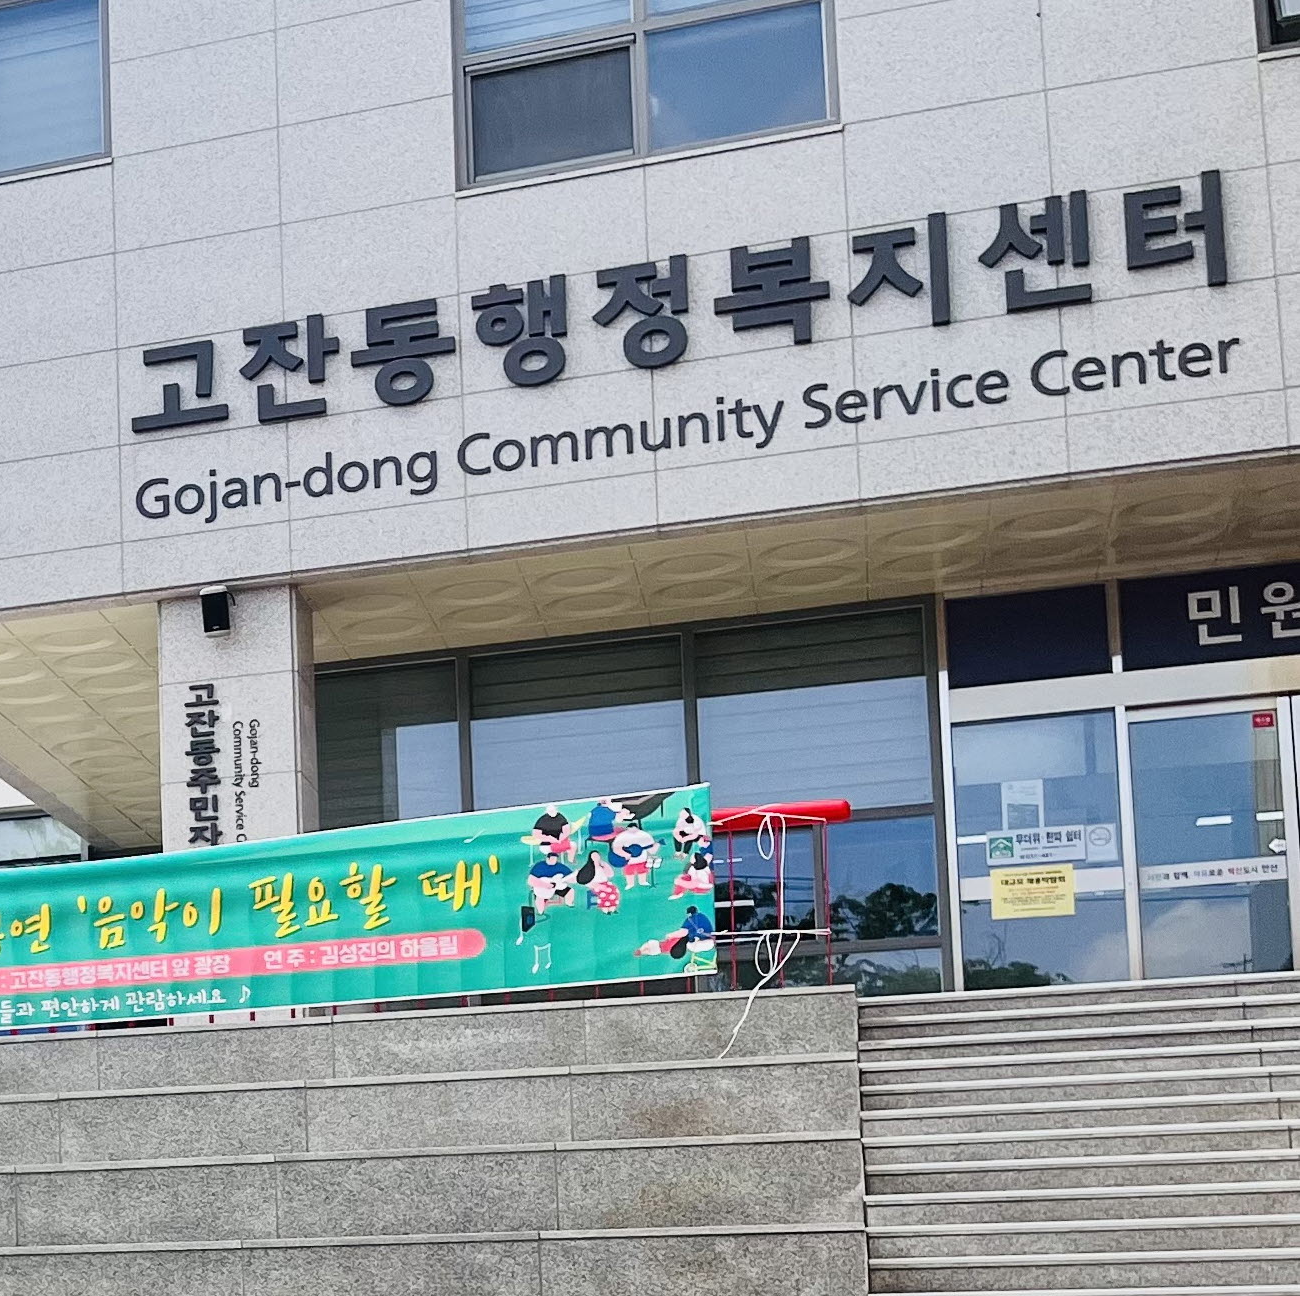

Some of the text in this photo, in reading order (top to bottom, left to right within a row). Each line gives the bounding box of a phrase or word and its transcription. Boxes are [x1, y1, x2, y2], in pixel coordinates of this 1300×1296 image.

[131, 169, 1228, 433] 고잔동행정복지센터
[136, 337, 1240, 524] Gojan-dong Community Service Center
[232, 720, 246, 788] Community
[247, 718, 262, 788] Gojan-dong
[235, 790, 248, 831] Service
[248, 862, 397, 938] 필요할
[10, 954, 168, 990] 고잔동행정복지센터
[171, 958, 190, 977] 앞
[193, 954, 231, 975] 광장
[319, 939, 396, 966] 김성진의
[41, 995, 120, 1018] 편안하게
[125, 988, 227, 1012] 관람하세요
